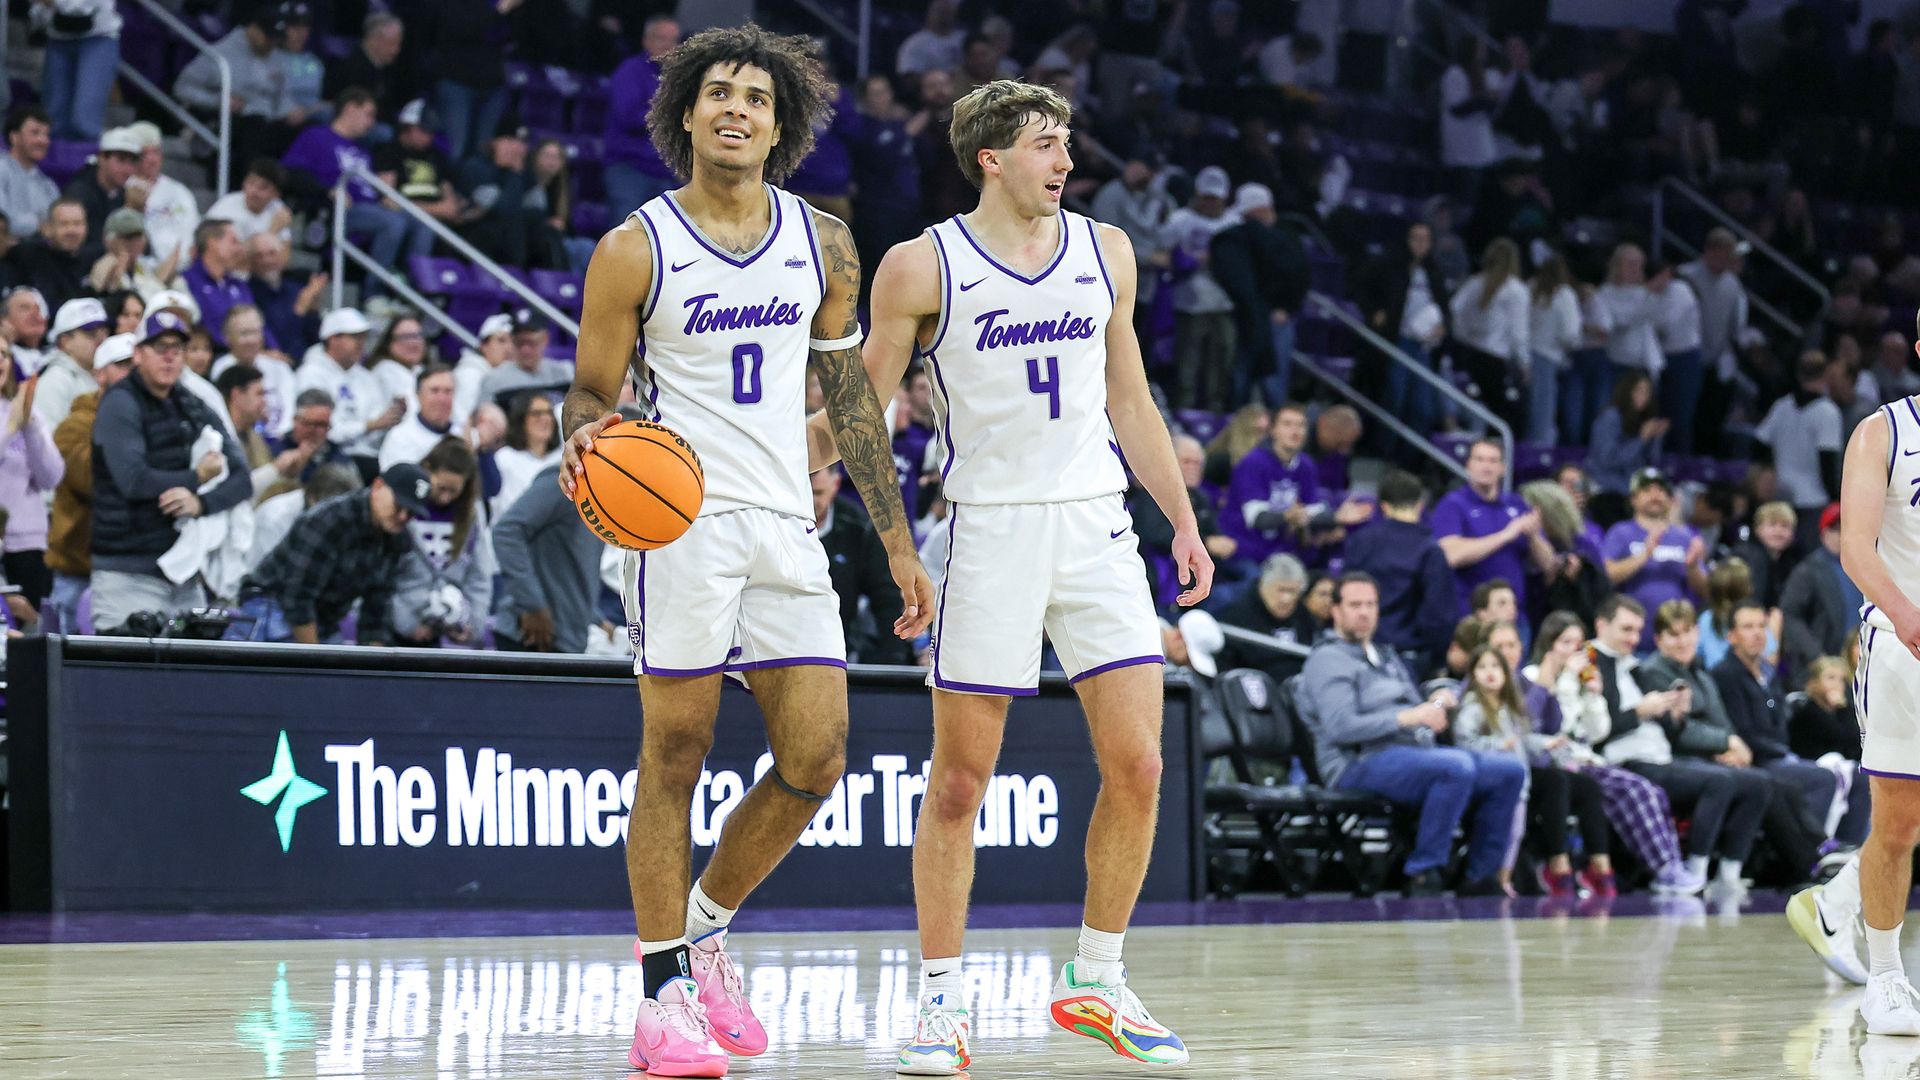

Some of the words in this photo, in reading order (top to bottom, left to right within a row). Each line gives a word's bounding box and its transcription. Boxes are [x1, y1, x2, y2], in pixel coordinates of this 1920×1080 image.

[683, 292, 804, 336] Tommies
[974, 309, 1097, 352] Tommies
[731, 343, 764, 404] 0
[1025, 356, 1061, 420] 4
[324, 738, 437, 848] The
